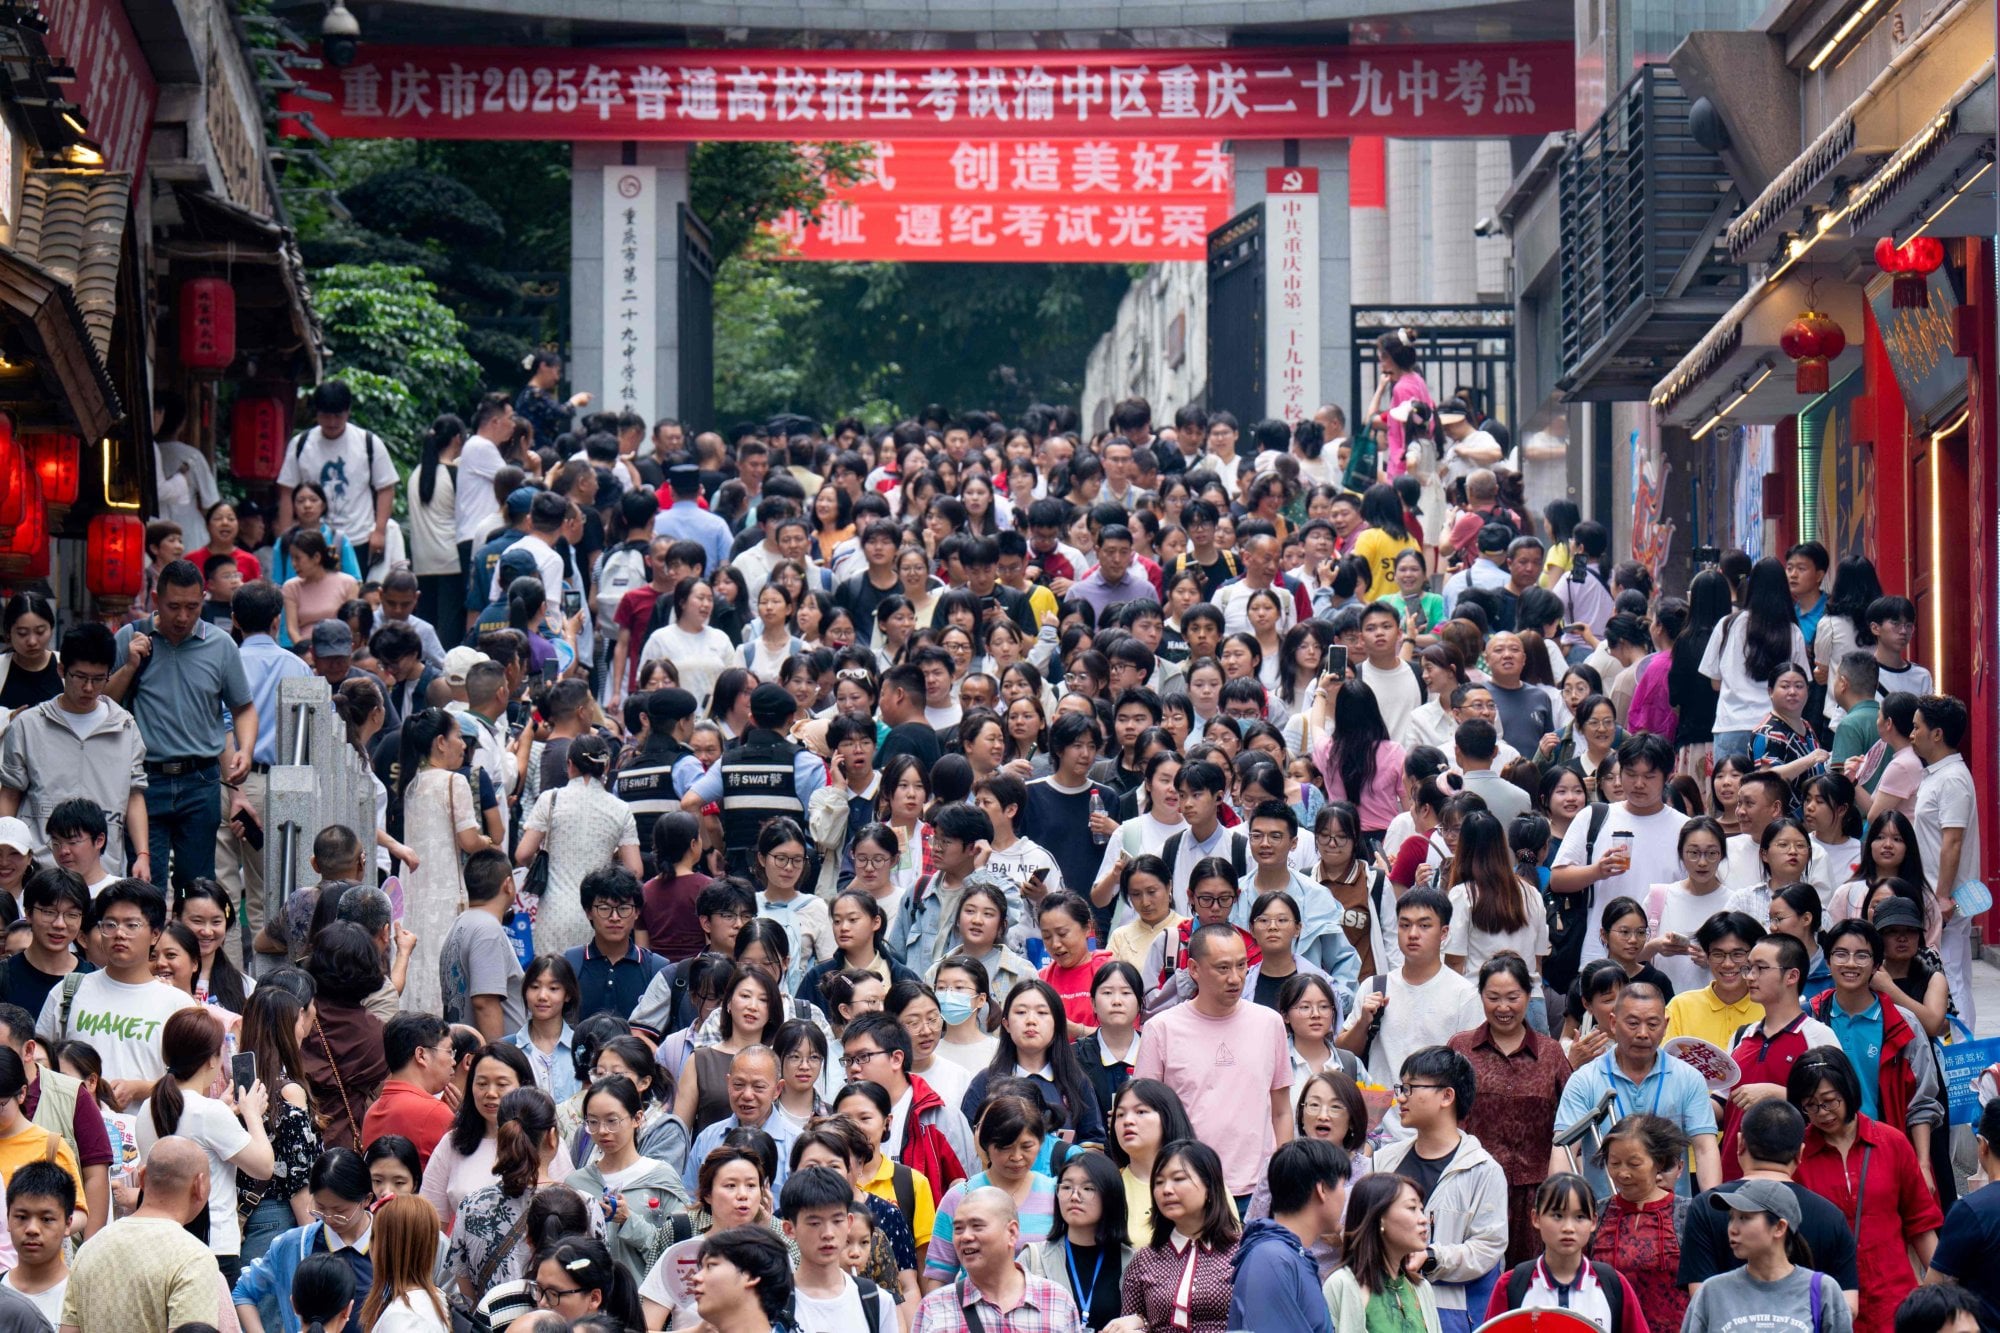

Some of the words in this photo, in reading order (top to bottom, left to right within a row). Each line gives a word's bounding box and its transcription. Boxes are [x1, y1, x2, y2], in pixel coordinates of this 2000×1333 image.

[341, 58, 1536, 123] 重庆市2025年普通高校招生考试渝中区重庆二十九中考点
[896, 204, 1208, 248] 遵纪考试光荣
